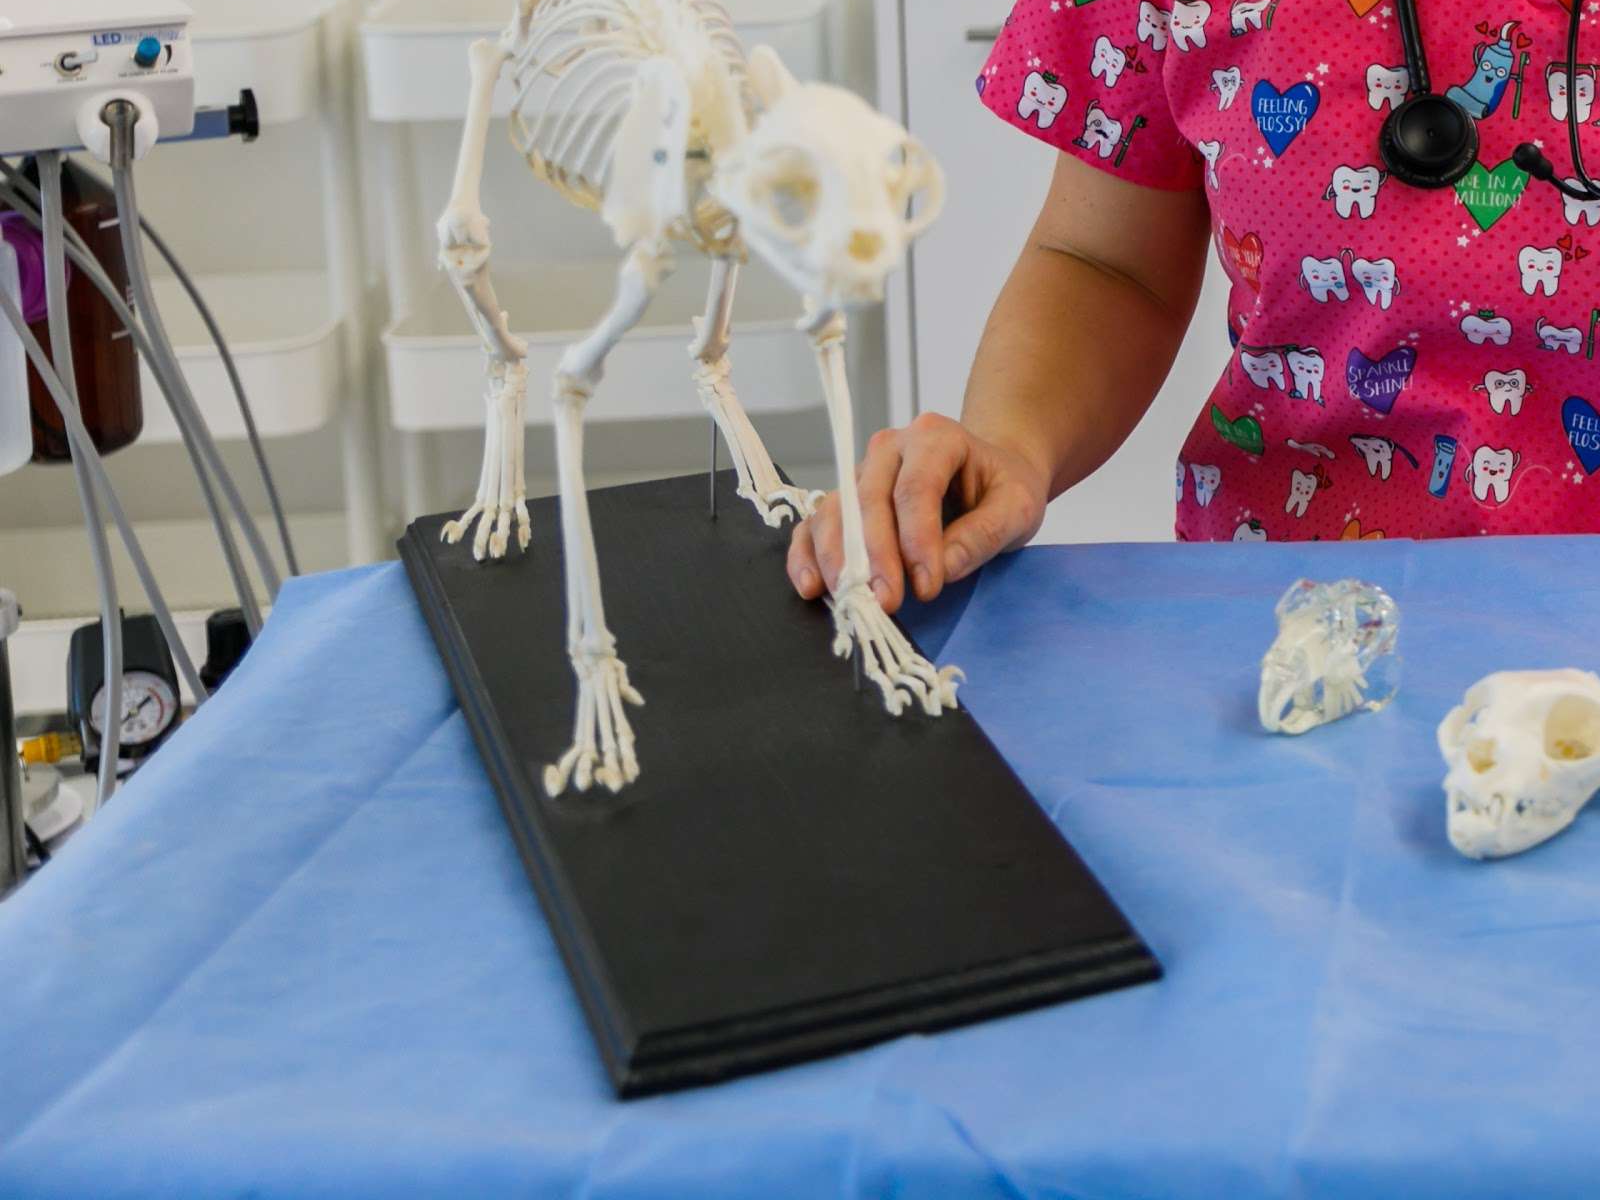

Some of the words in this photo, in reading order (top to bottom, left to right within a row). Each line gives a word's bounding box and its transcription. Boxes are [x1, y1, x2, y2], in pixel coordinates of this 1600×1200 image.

[93, 31, 121, 46] LED
[1258, 96, 1308, 116] FEELING
[1256, 114, 1308, 134] FLOSSY!
[1455, 174, 1481, 190] NE
[1487, 174, 1506, 190] IN
[1511, 175, 1526, 192] A
[1454, 190, 1522, 208] MILLION!
[1348, 358, 1411, 383] SPARKLE
